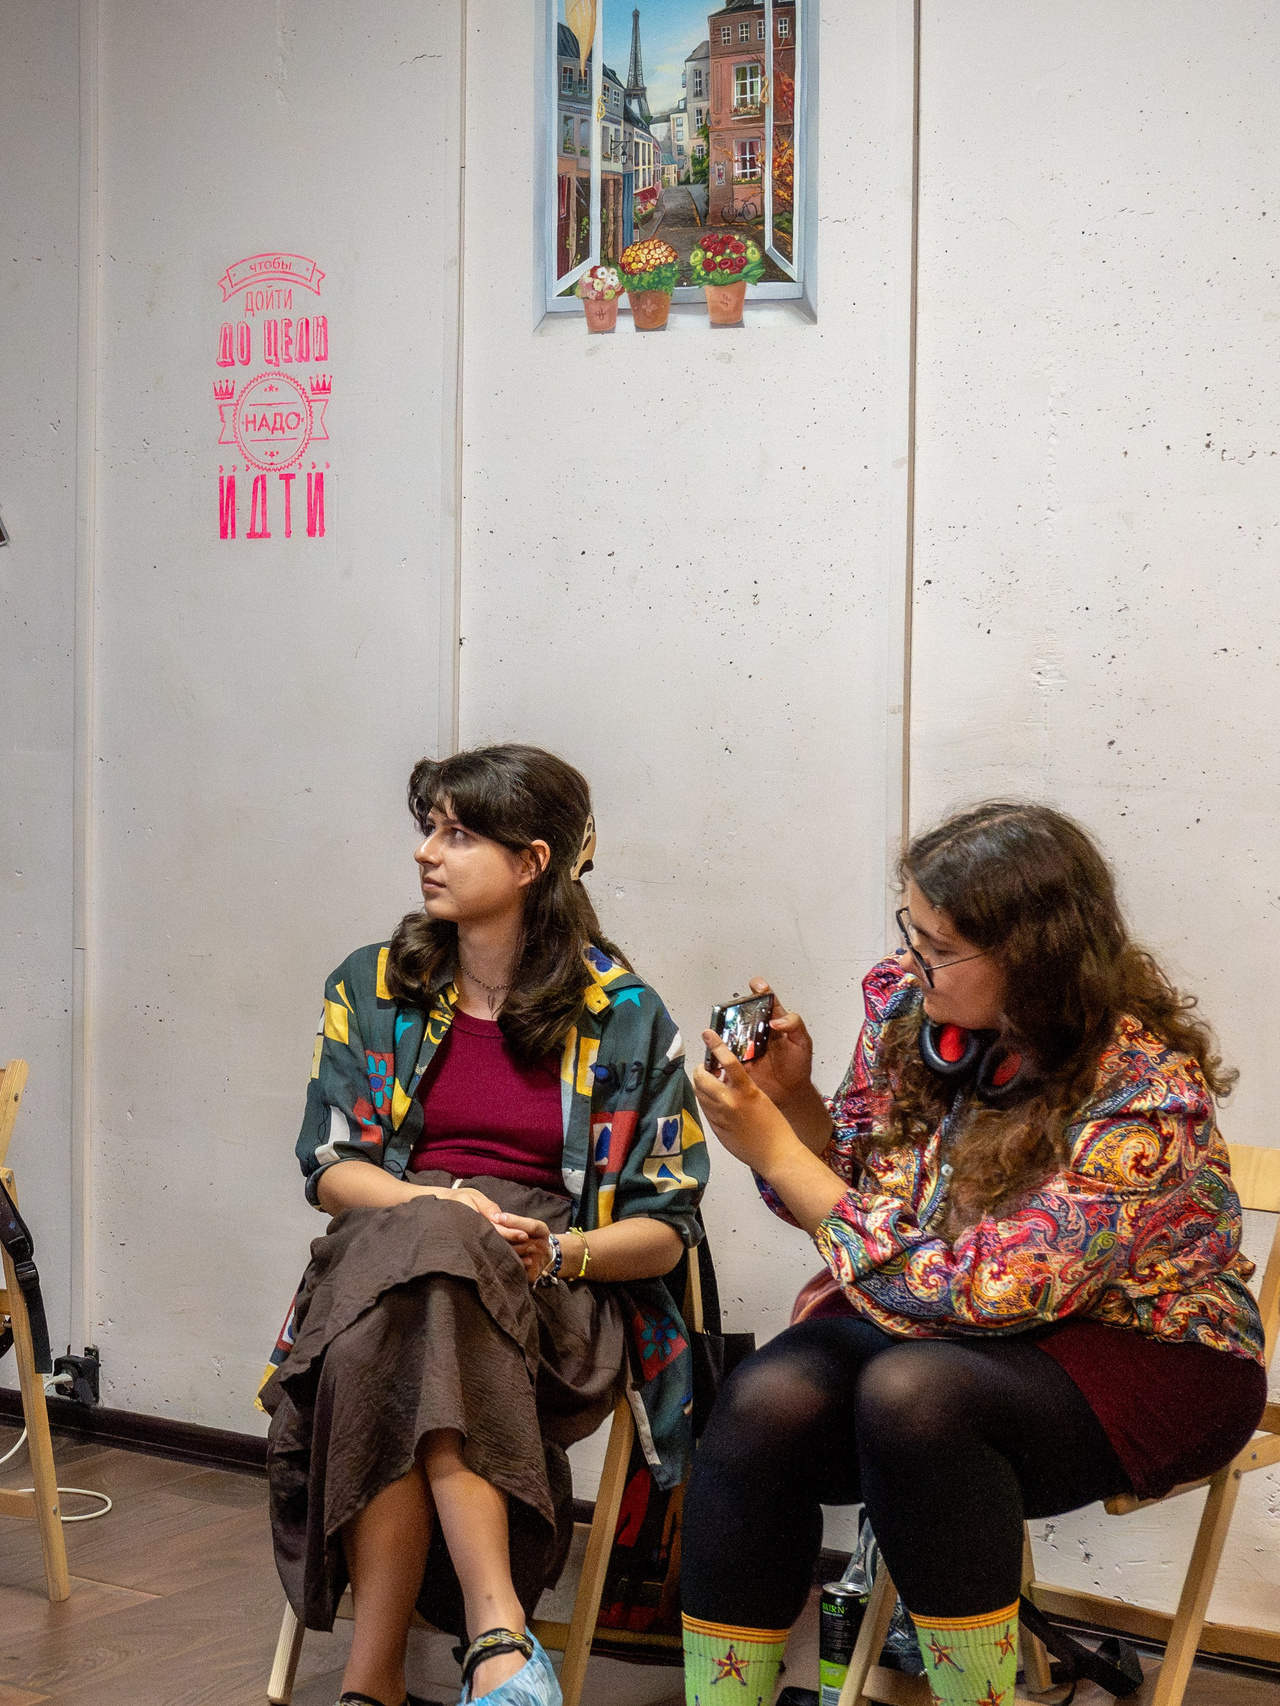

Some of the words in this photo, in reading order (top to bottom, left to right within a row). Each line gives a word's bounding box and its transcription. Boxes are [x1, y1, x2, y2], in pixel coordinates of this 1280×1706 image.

[244, 285, 293, 317] ДОЙТИ
[216, 321, 252, 368] ДО
[244, 411, 301, 434] НАДО
[219, 472, 325, 540] ИДТИ
